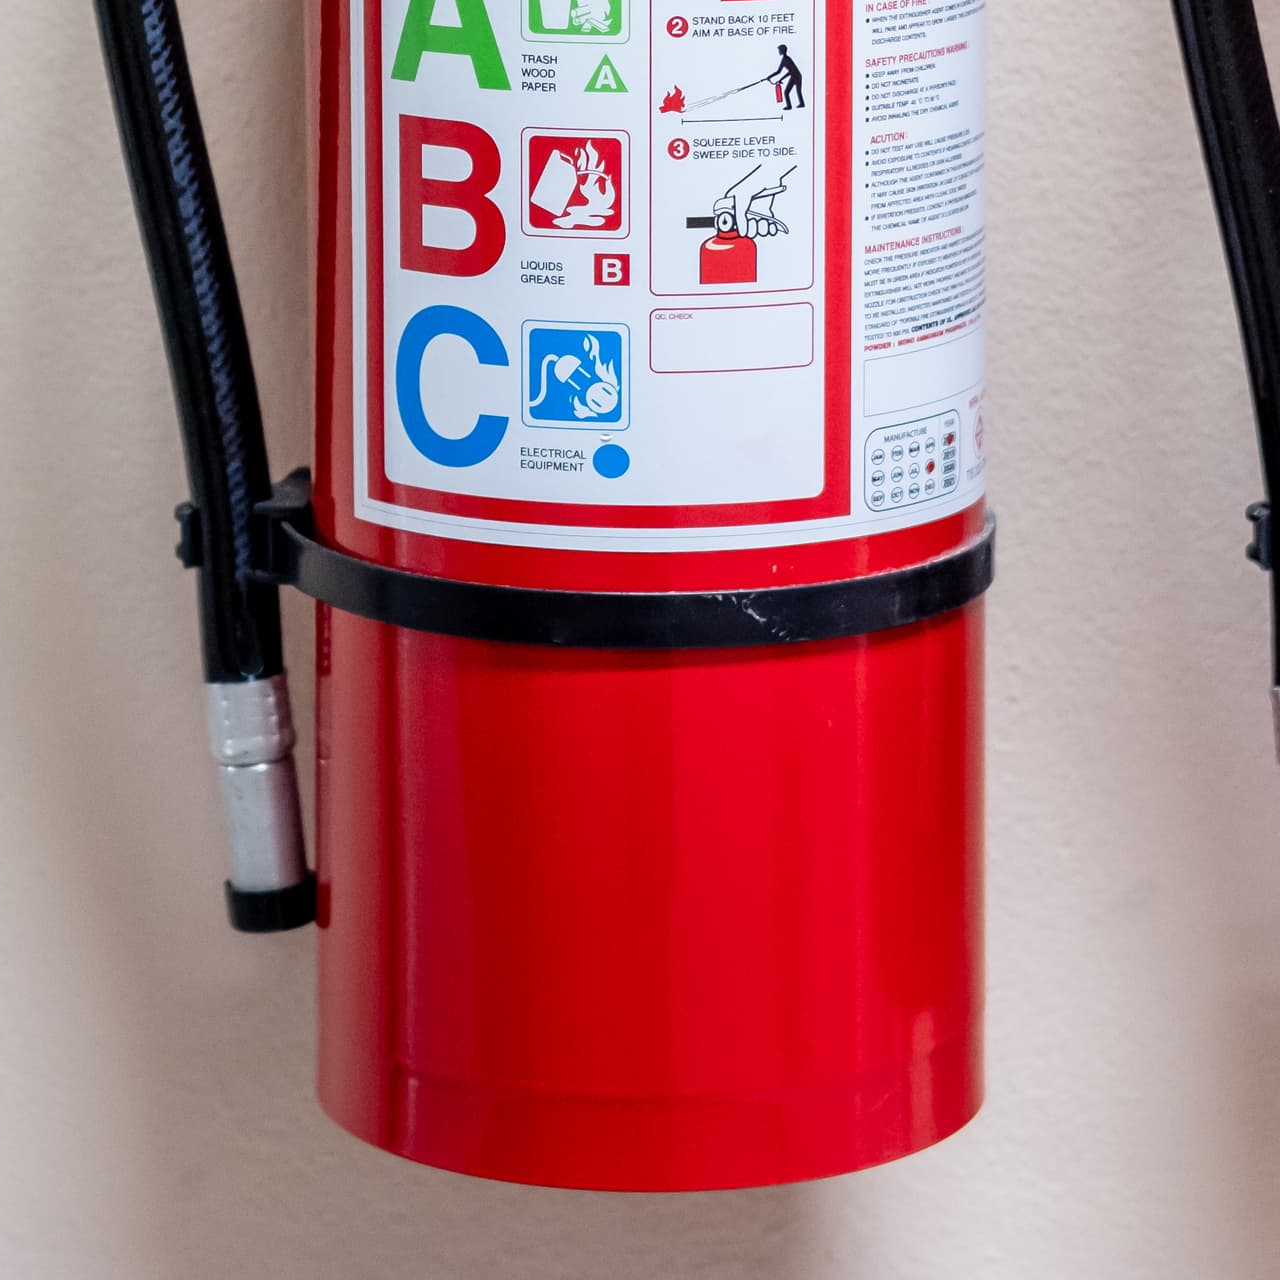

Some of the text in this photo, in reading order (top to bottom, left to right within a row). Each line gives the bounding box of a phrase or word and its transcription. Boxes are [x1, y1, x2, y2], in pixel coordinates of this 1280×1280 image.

[866, 3, 874, 12] IN
[876, 0, 897, 12] CASE
[900, 0, 910, 9] OF
[692, 13, 795, 25] STAND BACK 10 FEET
[671, 20, 683, 34] 2
[692, 26, 796, 37] AIM AT BASE OF FIRE.
[522, 54, 558, 65] TRASH
[866, 56, 897, 68] SAFETY
[899, 47, 945, 64] PRECAUTIONS
[522, 68, 555, 78] WOOD
[595, 65, 618, 89] A
[522, 82, 556, 92] PAPER
[693, 136, 775, 148] SQUEEZE LEVER
[870, 132, 905, 144] ACUTION
[673, 142, 684, 156] 3
[693, 151, 729, 159] SWEEP
[732, 149, 755, 158] SIDE
[757, 149, 770, 157] TO
[399, 114, 506, 277] B
[865, 237, 920, 254] MAINTENANCE
[520, 260, 563, 272] LIQUIDS
[602, 258, 623, 283] B
[520, 274, 565, 285] GREASE
[396, 304, 510, 468] C
[884, 427, 927, 442] MANUFACTURE
[520, 447, 587, 460] ELECTRICAL
[520, 460, 585, 472] EQUIPMENT
